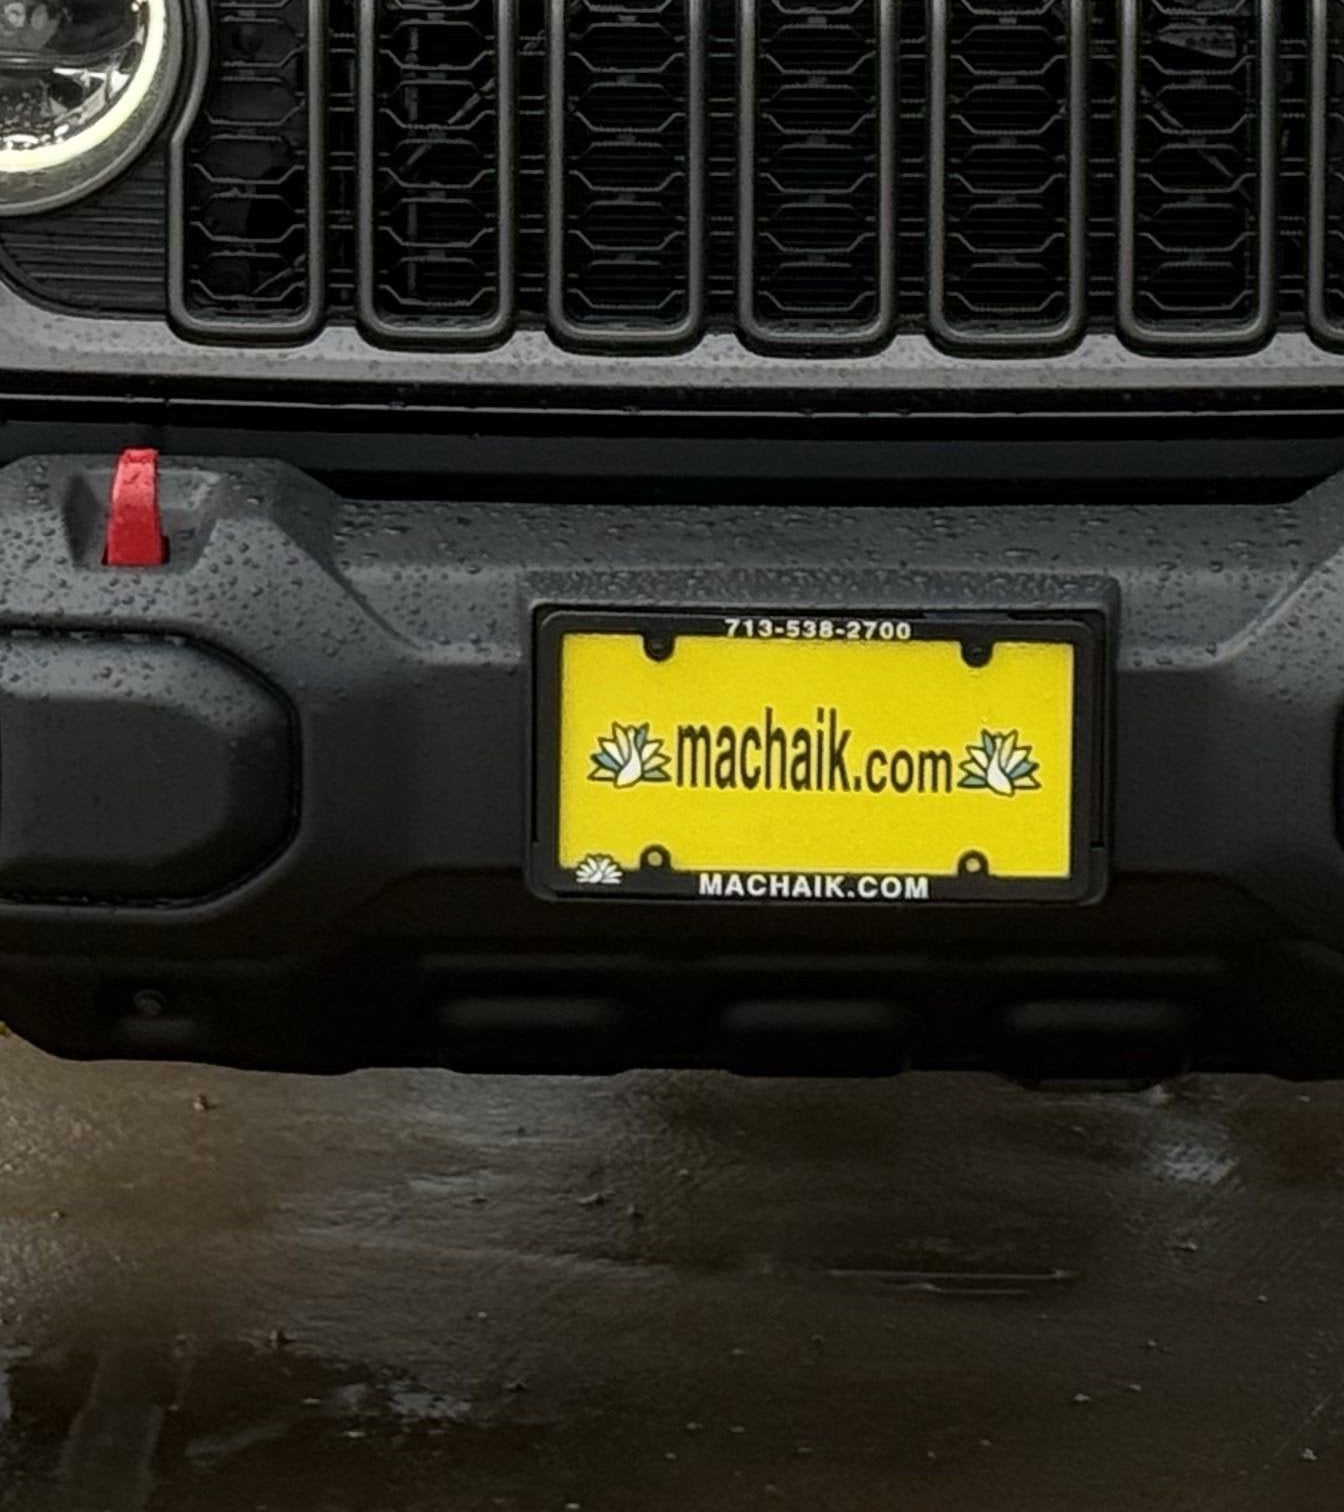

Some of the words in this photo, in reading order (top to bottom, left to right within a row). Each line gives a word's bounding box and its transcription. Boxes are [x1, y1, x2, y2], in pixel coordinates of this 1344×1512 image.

[725, 618, 911, 640] 713-538-2700
[675, 707, 953, 794] machaik.com
[698, 873, 929, 900] MACHAIK.COM
